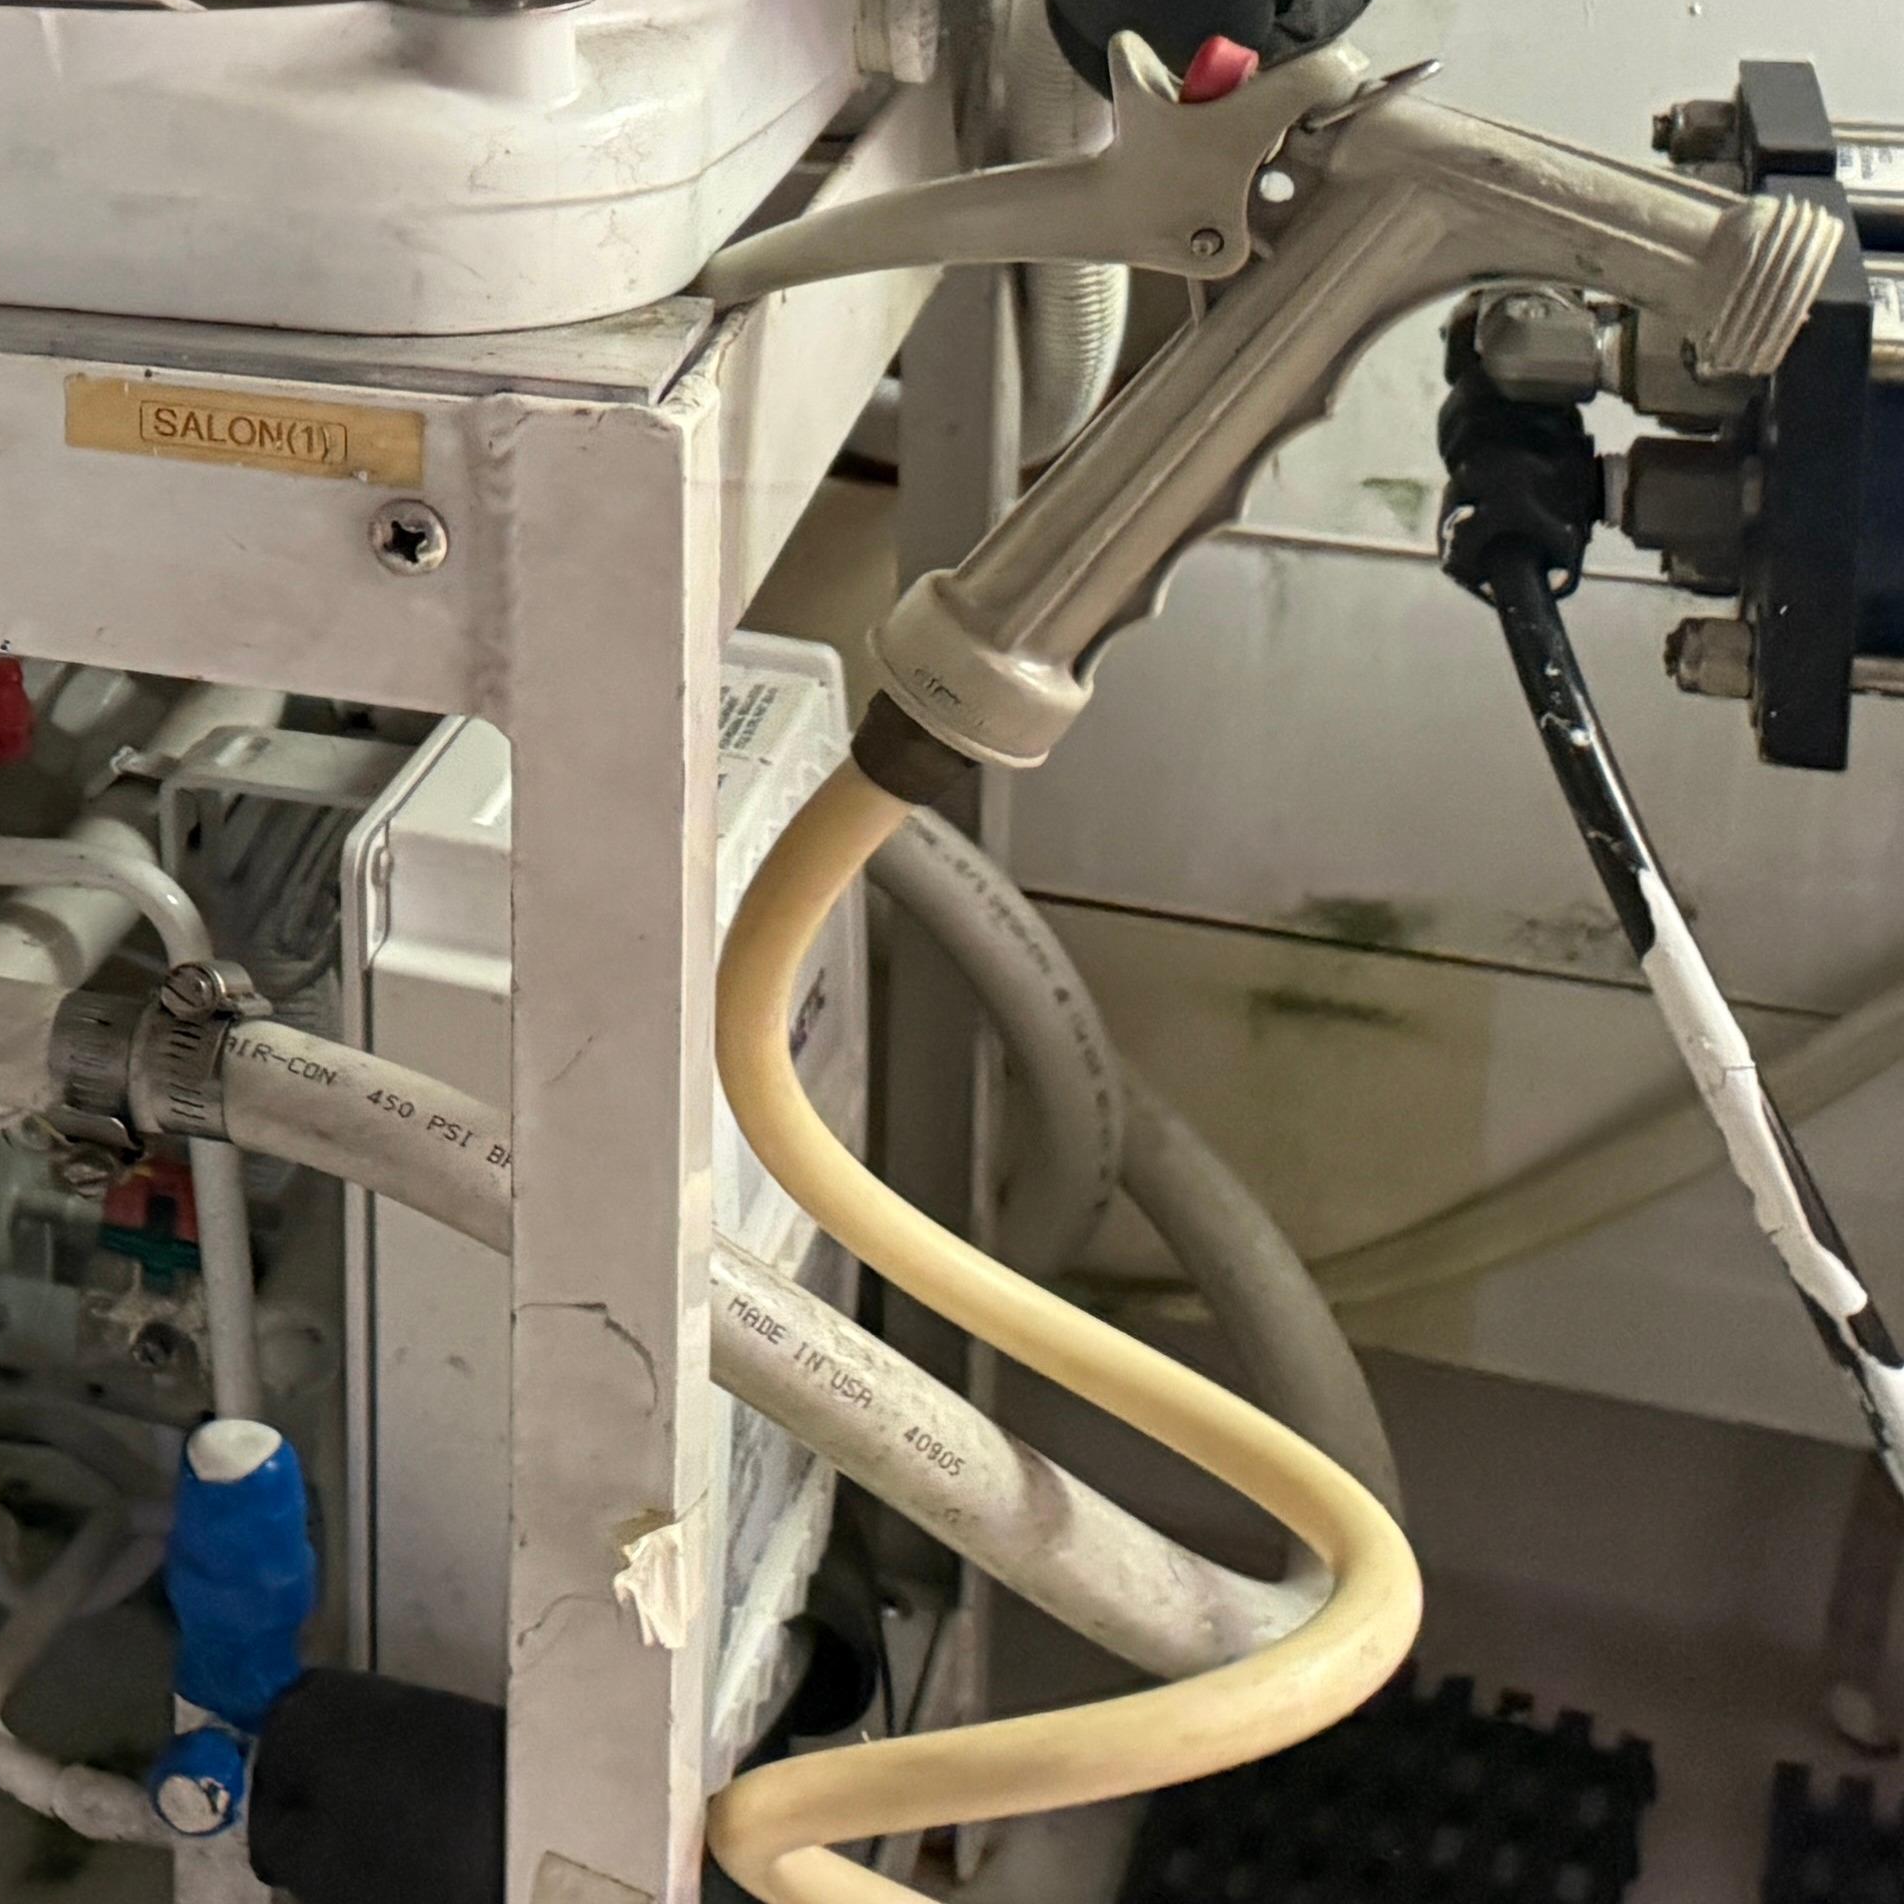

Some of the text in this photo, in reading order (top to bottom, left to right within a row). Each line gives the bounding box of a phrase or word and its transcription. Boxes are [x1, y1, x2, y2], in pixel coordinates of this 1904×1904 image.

[153, 407, 331, 463] SALON(1)
[366, 1090, 416, 1118] 450
[426, 1114, 475, 1148] PSI
[727, 1296, 787, 1345] MADE
[793, 1341, 826, 1373] IN
[830, 1370, 874, 1410] USA
